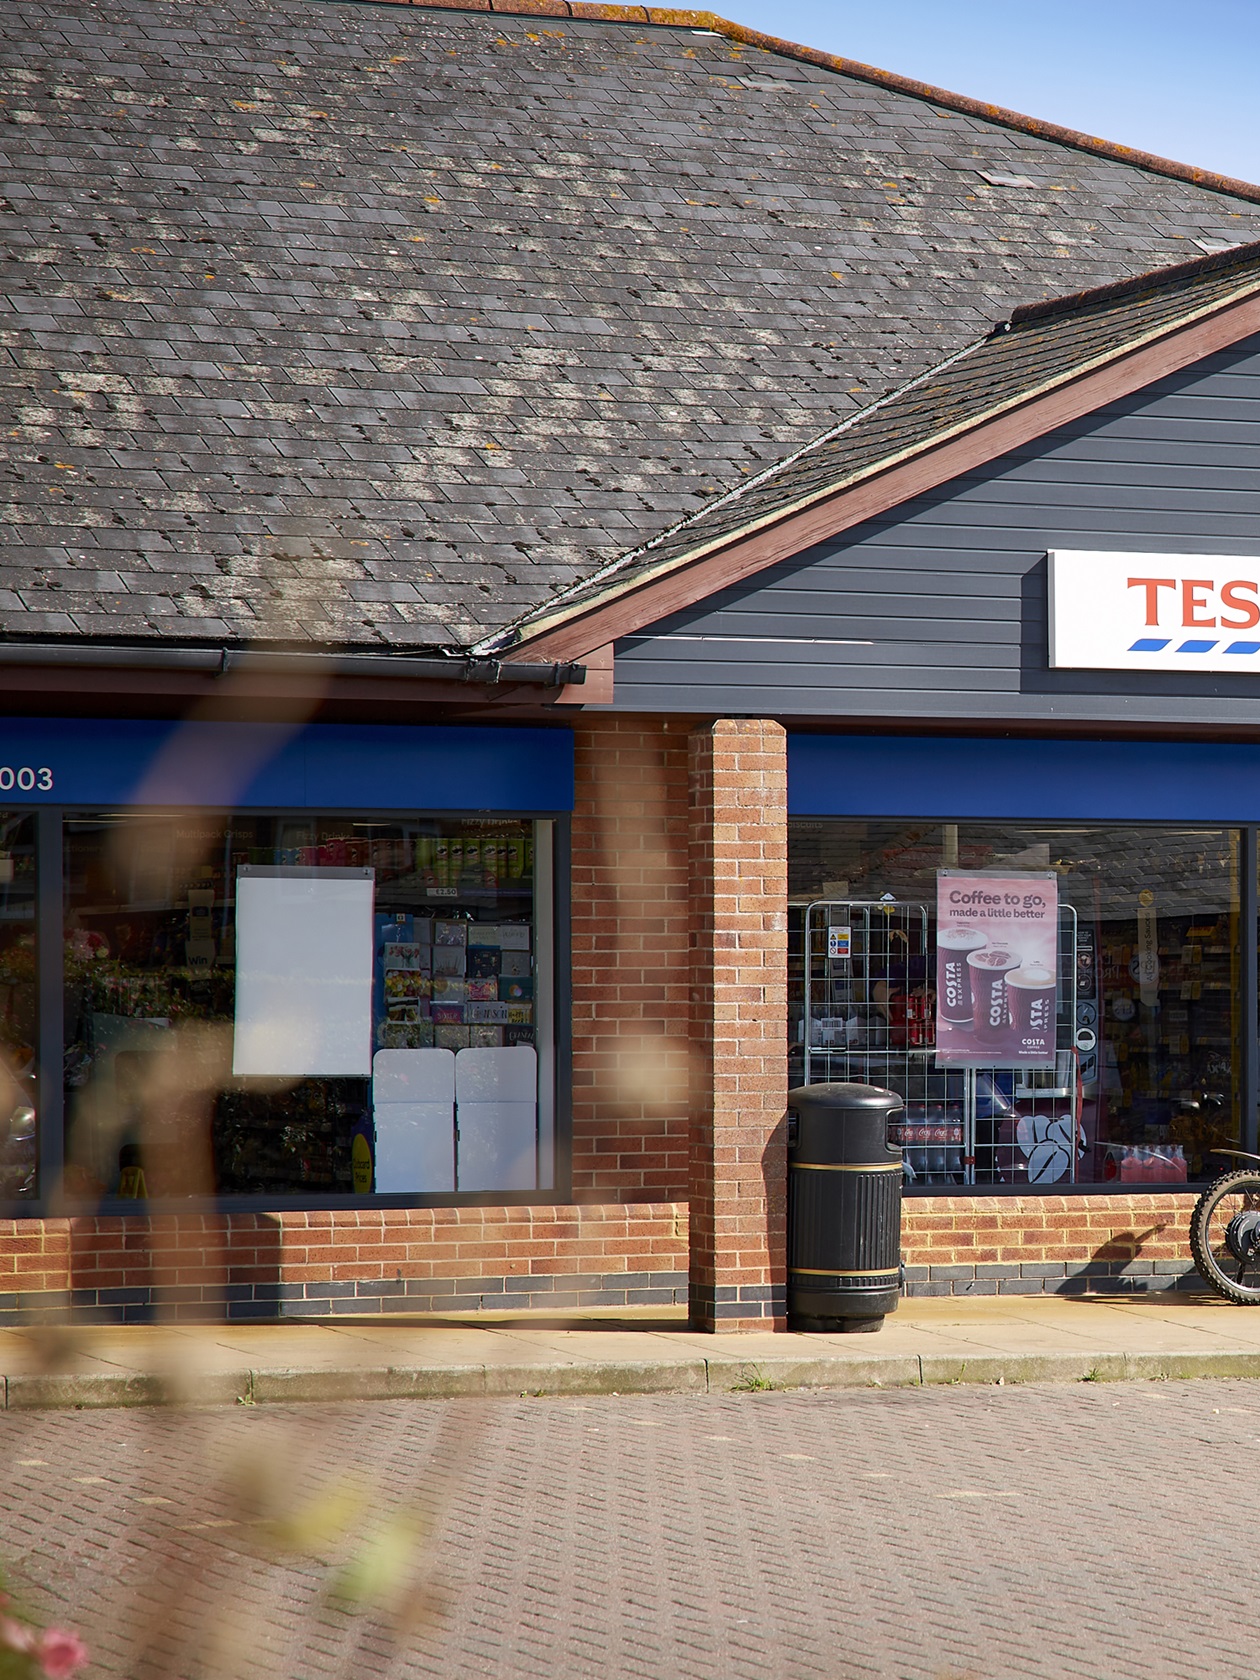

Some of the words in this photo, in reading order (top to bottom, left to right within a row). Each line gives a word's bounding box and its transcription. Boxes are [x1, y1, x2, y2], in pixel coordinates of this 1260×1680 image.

[176, 828, 222, 839] Multipack
[224, 829, 254, 840] Crisps
[296, 831, 319, 842] Fizzy
[949, 890, 1001, 905] Coffee
[1003, 893, 1020, 905] to
[1022, 895, 1046, 909] go,
[949, 907, 978, 917] made
[979, 909, 987, 917] a
[988, 908, 1011, 918] little
[1013, 909, 1045, 919] better
[188, 956, 208, 965] Win
[945, 962, 957, 1008] COSTA
[989, 979, 1003, 1027] COSTA
[1021, 1038, 1045, 1046] COSTA
